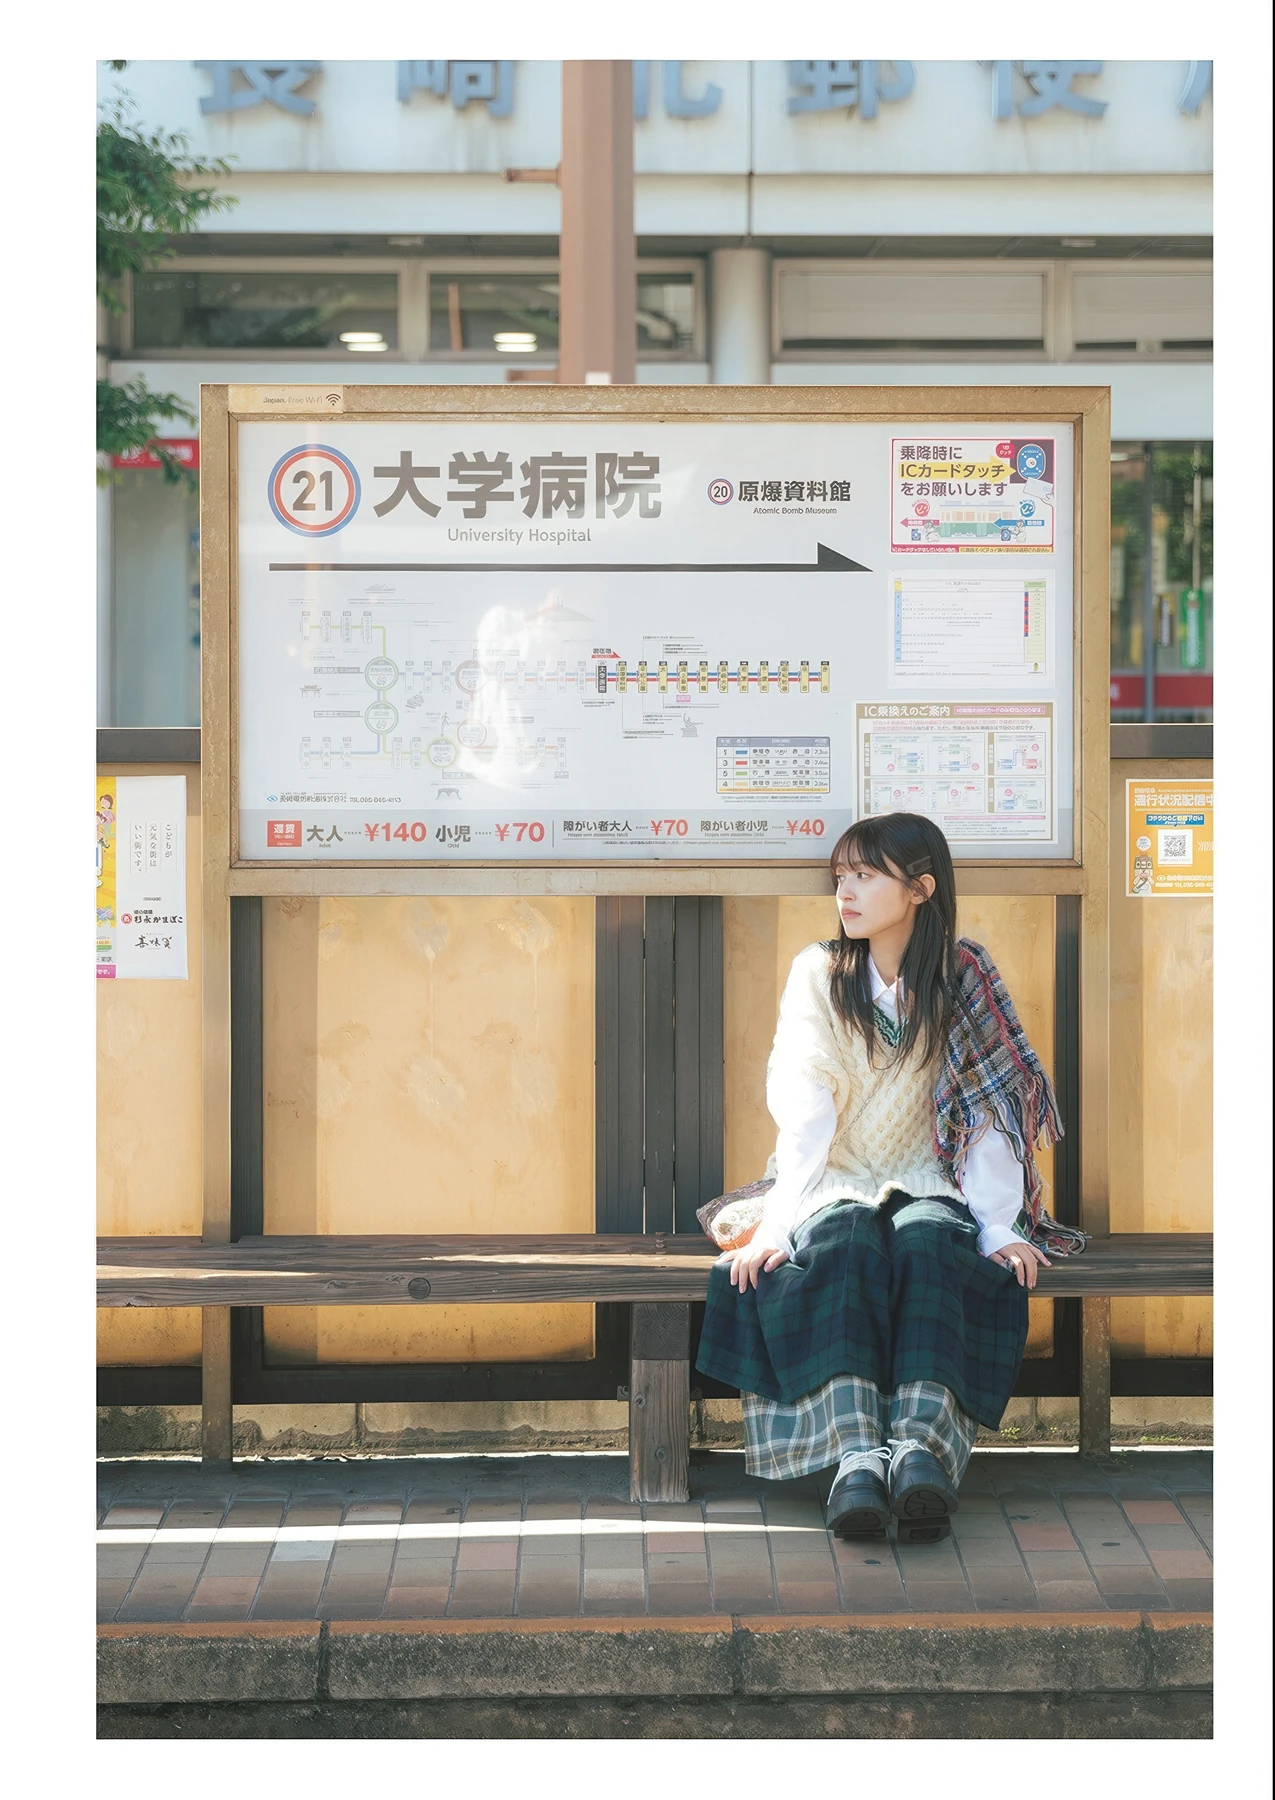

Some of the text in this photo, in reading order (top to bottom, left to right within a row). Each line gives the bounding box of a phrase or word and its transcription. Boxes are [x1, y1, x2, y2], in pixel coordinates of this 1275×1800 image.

[900, 445, 963, 461] 乗降時に
[900, 464, 1005, 478] ICカードタッチ
[291, 470, 334, 511] 21
[372, 450, 663, 520] 大学病院
[713, 485, 729, 499] 20
[738, 480, 852, 502] 原爆資料館
[900, 482, 1008, 497] をお願いします
[753, 507, 838, 515] Atomic Bomb Museum
[447, 527, 592, 546] University Hospital
[864, 705, 950, 717] IC乗換えのご案内
[306, 822, 545, 842] 大人 ¥140 小児 ¥70
[563, 819, 825, 837] 障がい者大人 ¥70 障がい者小児 ¥40
[164, 823, 173, 858] こどもが
